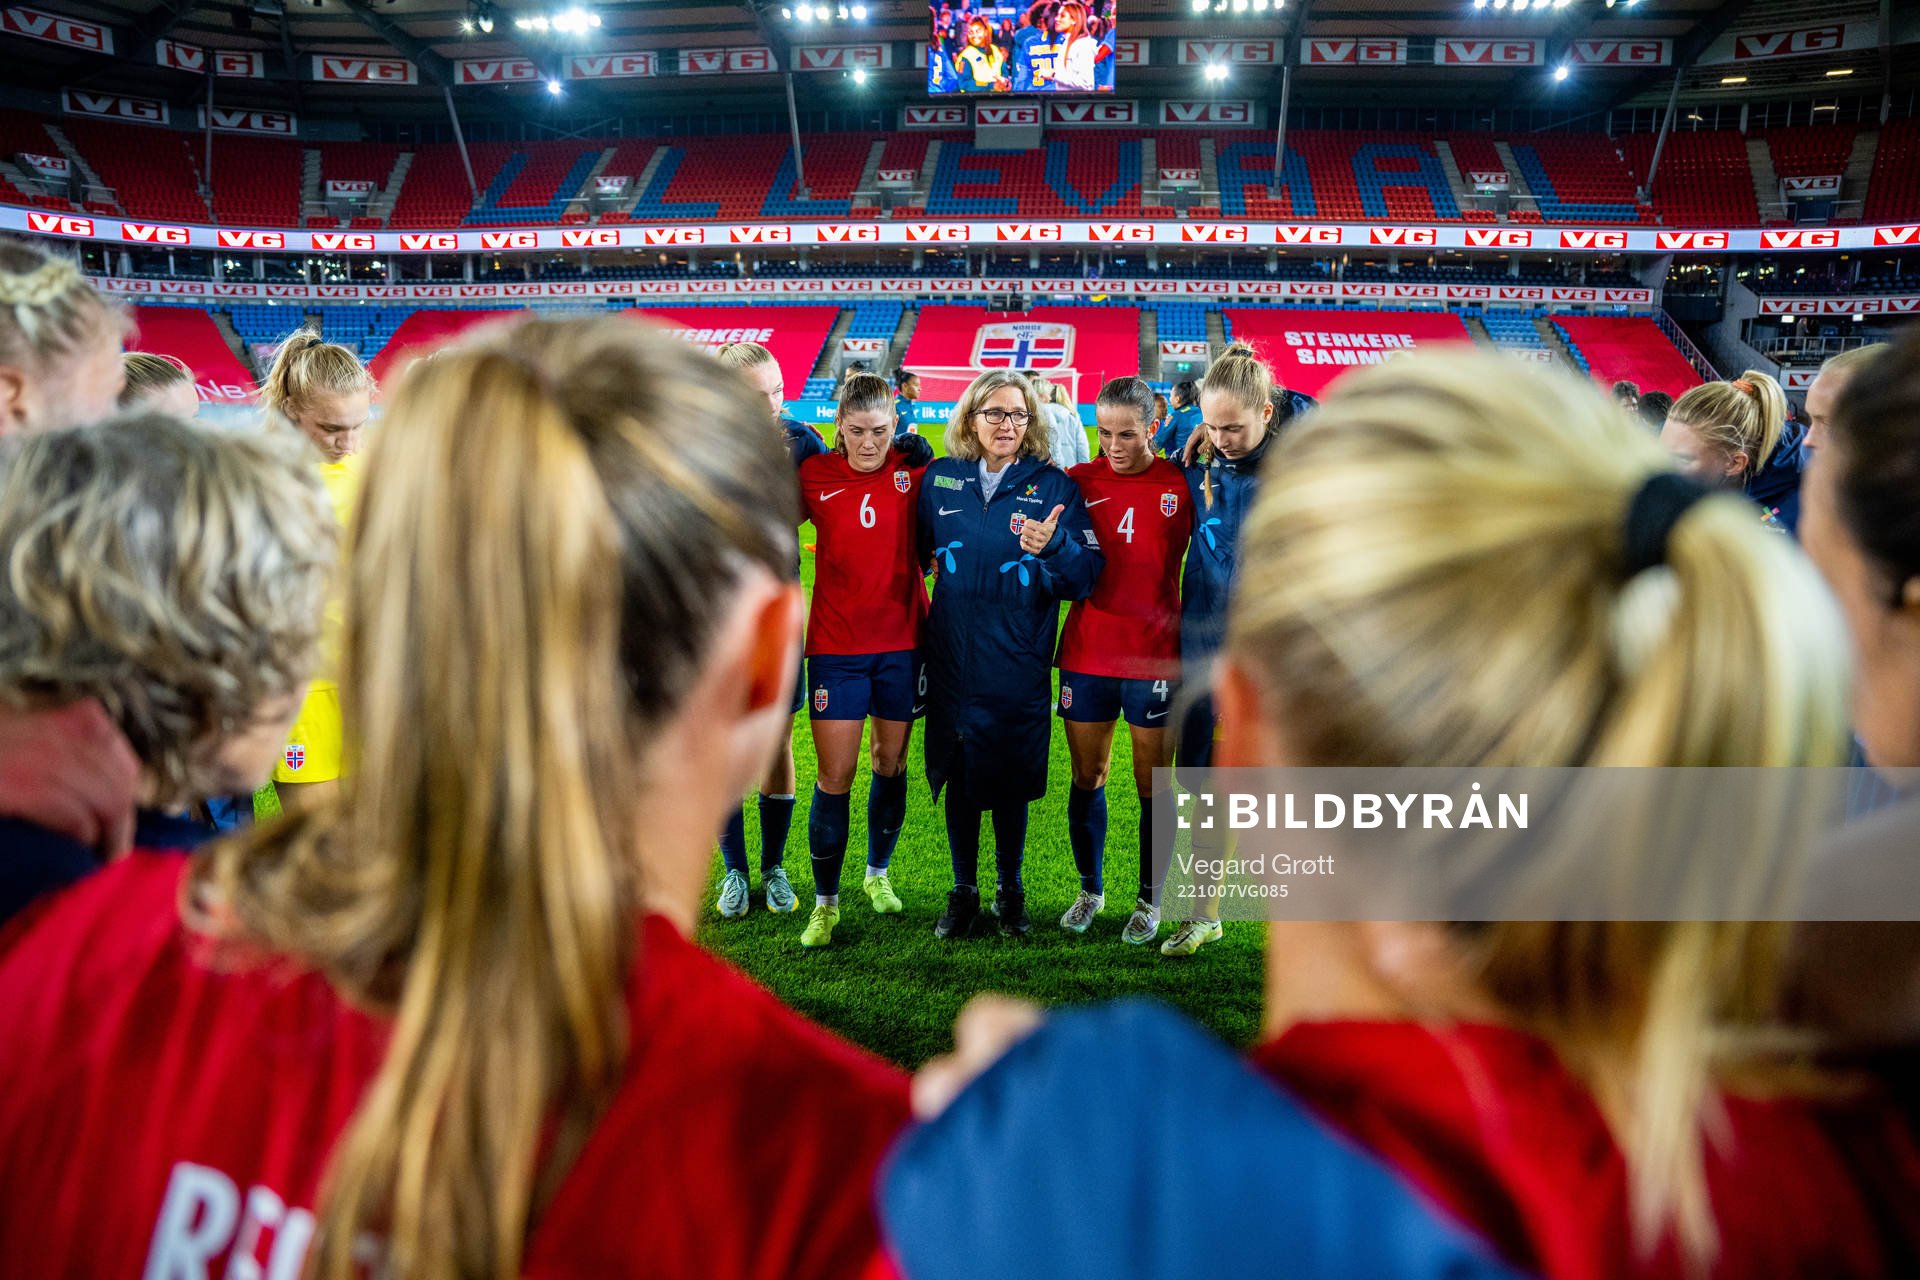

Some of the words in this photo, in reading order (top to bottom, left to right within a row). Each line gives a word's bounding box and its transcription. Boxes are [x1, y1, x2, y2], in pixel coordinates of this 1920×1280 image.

[7, 9, 97, 49] VG
[1740, 28, 1838, 56] VG
[803, 47, 878, 68] VG
[1189, 42, 1270, 62] VG
[1315, 42, 1394, 62] VG
[1448, 42, 1531, 62] VG
[1576, 42, 1658, 62] VG
[174, 47, 249, 74] VG
[575, 57, 646, 76] VG
[690, 51, 765, 71] VG
[326, 60, 403, 79] VG
[466, 63, 536, 81] VG
[73, 93, 158, 119] VG
[1054, 104, 1132, 121] VG
[1168, 104, 1246, 120] VG
[217, 111, 288, 131] VG
[909, 110, 963, 123] VG
[980, 109, 1036, 122] VG
[28, 156, 64, 170] VG
[598, 177, 627, 187] VG
[880, 171, 913, 181] VG
[1163, 170, 1197, 180] VG
[1472, 174, 1507, 184] VG
[334, 182, 368, 191] VG
[1789, 178, 1835, 189] VG
[29, 214, 92, 236] VG
[124, 226, 187, 243] VG
[564, 231, 617, 246] VG
[647, 229, 701, 244] VG
[732, 227, 788, 242] VG
[819, 226, 876, 241] VG
[908, 226, 966, 240] VG
[999, 226, 1058, 239] VG
[1091, 226, 1151, 240] VG
[1184, 226, 1245, 241] VG
[1277, 228, 1339, 243] VG
[1372, 229, 1434, 244] VG
[1466, 231, 1529, 246] VG
[1562, 232, 1625, 247] VG
[1764, 231, 1835, 247] VG
[1878, 227, 1920, 245] V
[219, 232, 282, 248] VG
[314, 235, 372, 249] VG
[402, 235, 455, 249] VG
[483, 233, 535, 248] VG
[1659, 232, 1726, 248] VG
[107, 279, 150, 291] VG
[160, 281, 204, 293] VG
[213, 284, 257, 295] VG
[266, 286, 307, 297] VG
[317, 287, 358, 297] VG
[415, 288, 450, 296] VG
[461, 287, 495, 296] VG
[505, 285, 540, 295] VG
[550, 284, 584, 294] VG
[596, 284, 631, 293] VG
[642, 283, 677, 292] VG
[689, 282, 725, 292] VG
[736, 281, 773, 291] VG
[784, 282, 821, 291] VG
[833, 281, 871, 290] VG
[882, 280, 921, 290] VG
[932, 280, 971, 290] VG
[1033, 281, 1073, 291] VG
[1084, 281, 1124, 291] VG
[1135, 282, 1174, 292] VG
[1187, 282, 1227, 292] VG
[1239, 283, 1279, 294] VG
[1291, 283, 1332, 294] VG
[1343, 284, 1385, 295] VG
[1395, 285, 1437, 297] VG
[367, 287, 405, 298] VG
[1448, 287, 1489, 298] VG
[1500, 288, 1541, 298] VG
[1553, 289, 1595, 300] VG
[1606, 290, 1647, 301] VG
[1766, 302, 1815, 312] VG
[1827, 301, 1879, 312] VG
[1891, 300, 1920, 311] V
[660, 328, 774, 342] TERKERE
[1284, 331, 1416, 348] STERKERE
[843, 340, 884, 350] VG
[1163, 343, 1206, 354] VG
[1296, 348, 1392, 365] SAMM
[194, 379, 247, 400] NB
[859, 493, 876, 529] 6
[1117, 507, 1135, 543] 4
[918, 662, 927, 696] 6
[1152, 679, 1169, 702] 4
